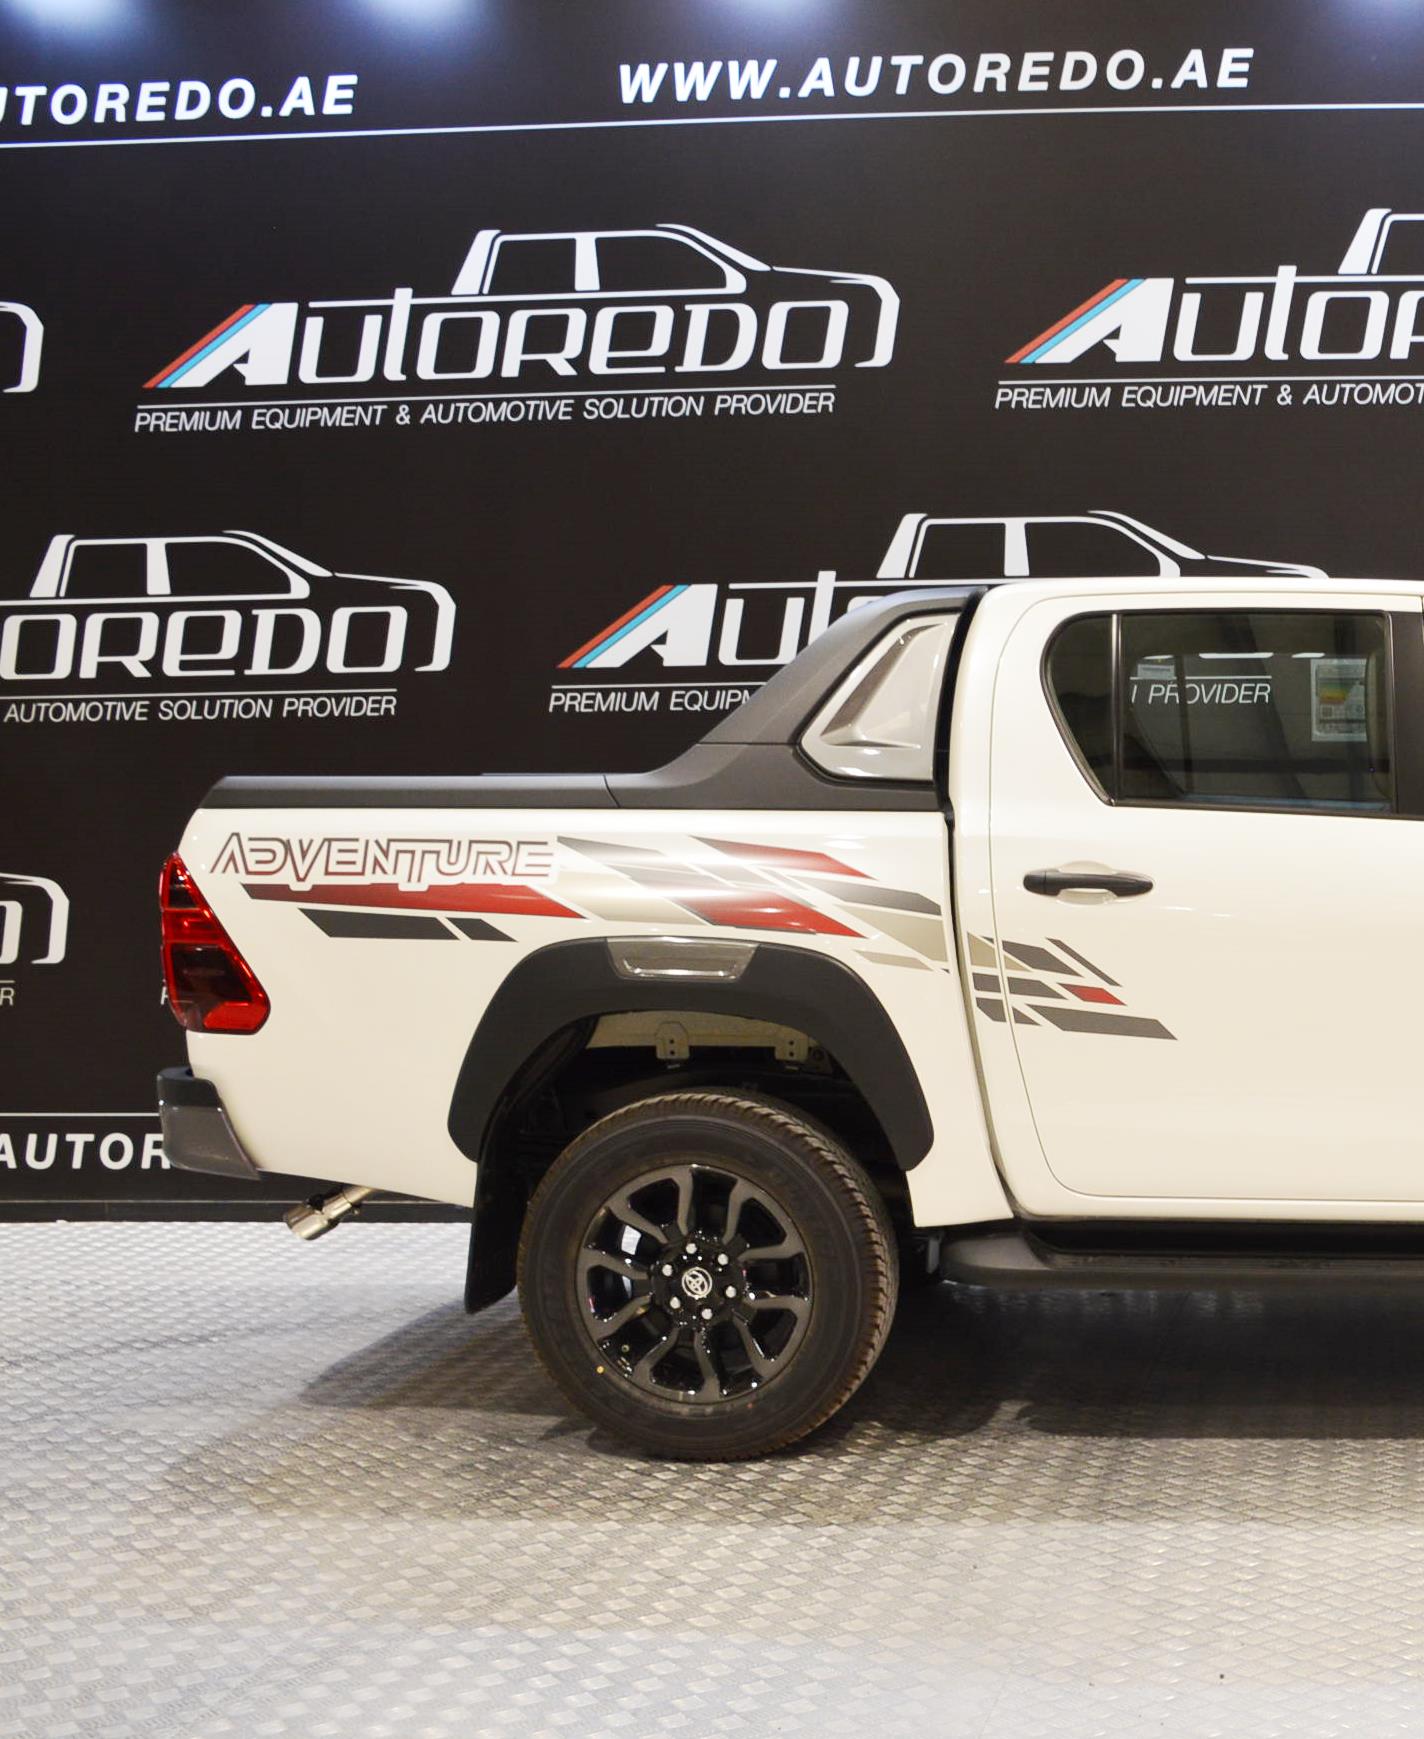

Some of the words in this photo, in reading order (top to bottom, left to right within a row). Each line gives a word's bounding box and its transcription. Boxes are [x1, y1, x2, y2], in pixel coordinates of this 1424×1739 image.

[619, 47, 1255, 104] WWW.AUTOREDO.AE
[0, 74, 358, 126] TOREDO.AE
[995, 387, 1111, 408] PREMIUM
[1122, 385, 1268, 407] EQUIPMENT
[1277, 384, 1292, 405] &
[135, 410, 241, 432] PREMIUM
[252, 406, 387, 429] EQUIPMENT
[396, 405, 410, 424] &
[421, 400, 574, 424] AUTOMOTIVE
[584, 396, 704, 419] SOLUTION
[715, 393, 835, 415] PROVIDER
[4, 701, 149, 722] AUTOMOTIVE
[159, 699, 272, 720] SOLUTION
[283, 696, 396, 717] PROVIDER
[549, 691, 659, 712] PREMIUM
[1149, 684, 1270, 704] PROVIDER
[210, 832, 554, 884] ADVENTURE
